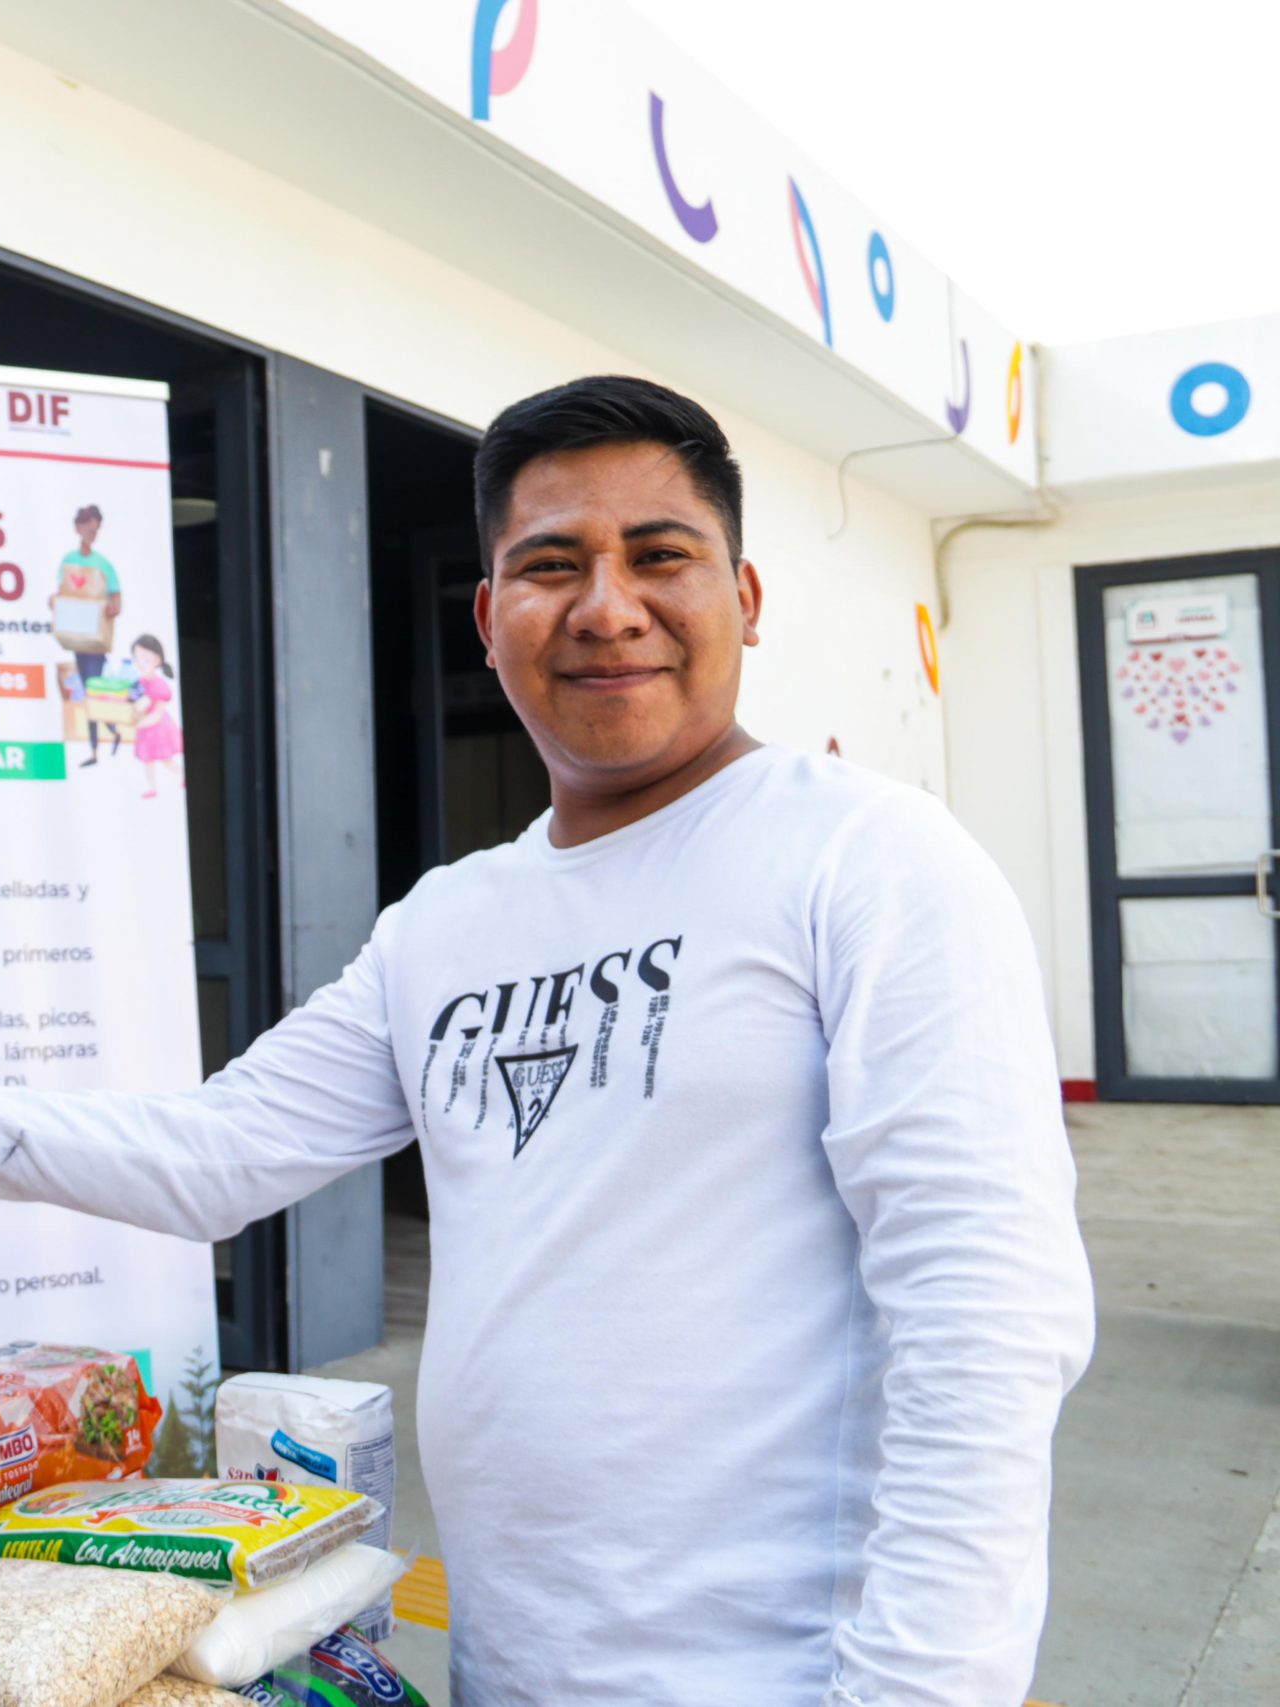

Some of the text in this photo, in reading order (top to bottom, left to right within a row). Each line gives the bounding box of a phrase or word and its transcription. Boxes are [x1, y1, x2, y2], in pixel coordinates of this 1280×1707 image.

[8, 390, 71, 428] DIF
[77, 883, 89, 902] y
[2, 945, 93, 967] primeros
[429, 935, 683, 1041] GUESS
[38, 1008, 96, 1032] picos,
[4, 1040, 98, 1063] lámparas
[15, 1267, 104, 1297] personal.
[3, 1461, 40, 1483] TOSTADO
[2, 1538, 63, 1563] LENTEJA
[74, 1537, 105, 1565] Los
[107, 1540, 222, 1573] Arrayanes
[321, 1638, 394, 1694] ueno
